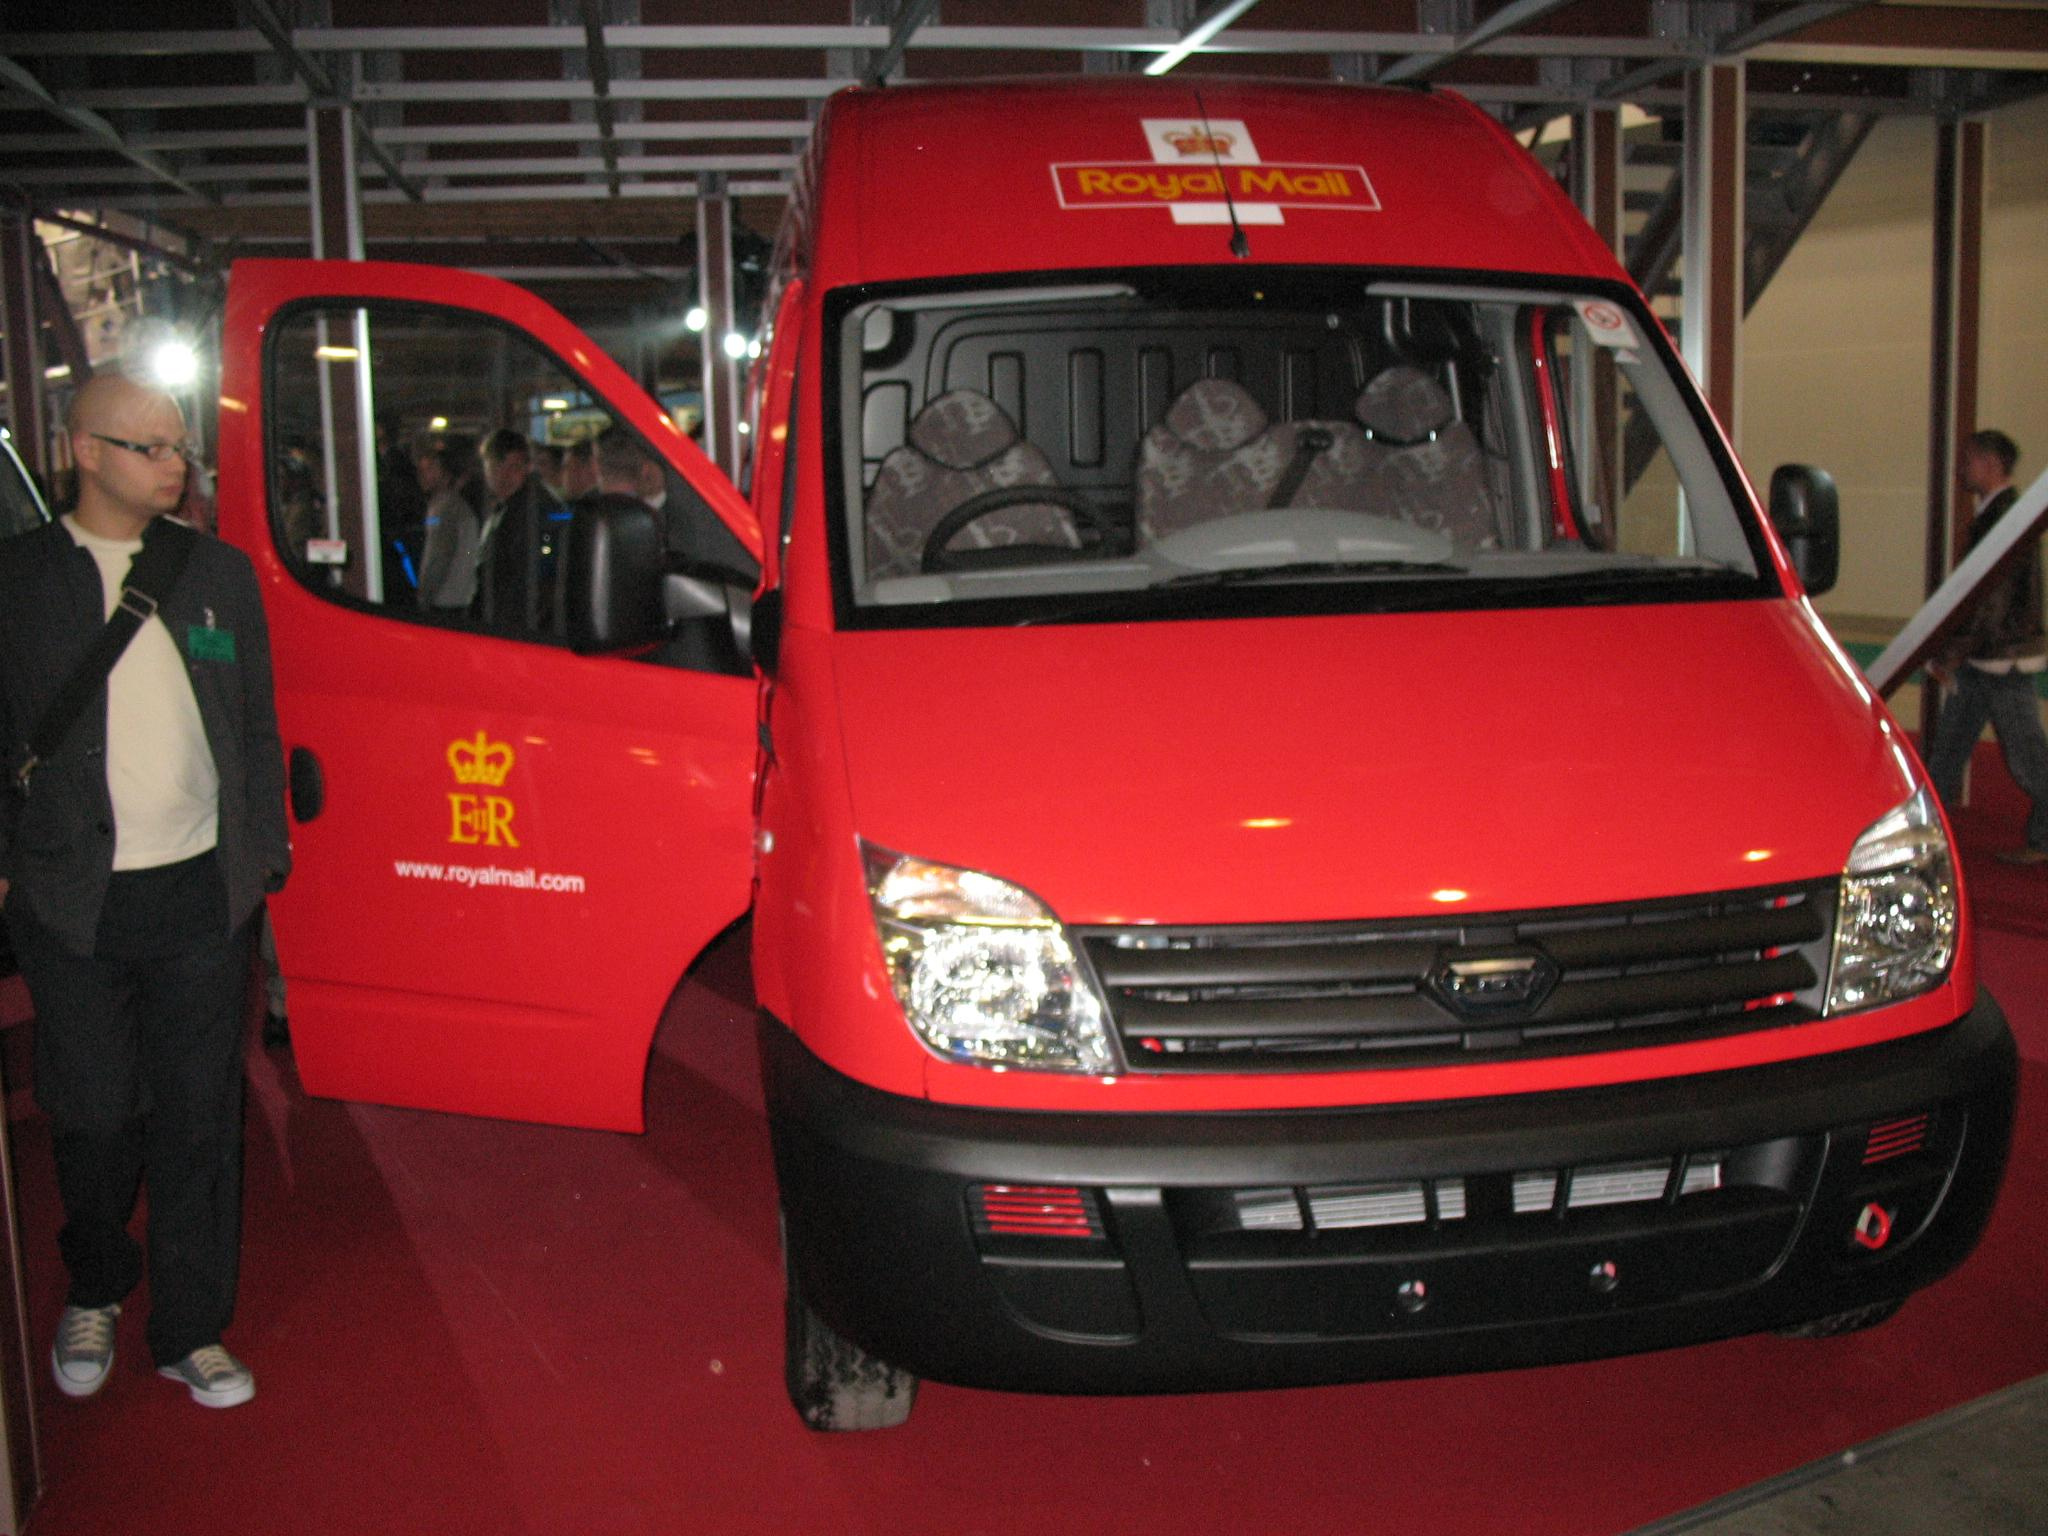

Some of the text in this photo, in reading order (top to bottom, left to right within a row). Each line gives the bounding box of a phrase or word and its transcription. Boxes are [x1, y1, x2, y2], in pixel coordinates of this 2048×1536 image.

[1077, 169, 1352, 199] Royal Mail
[394, 860, 585, 892] www.royalmail.com
